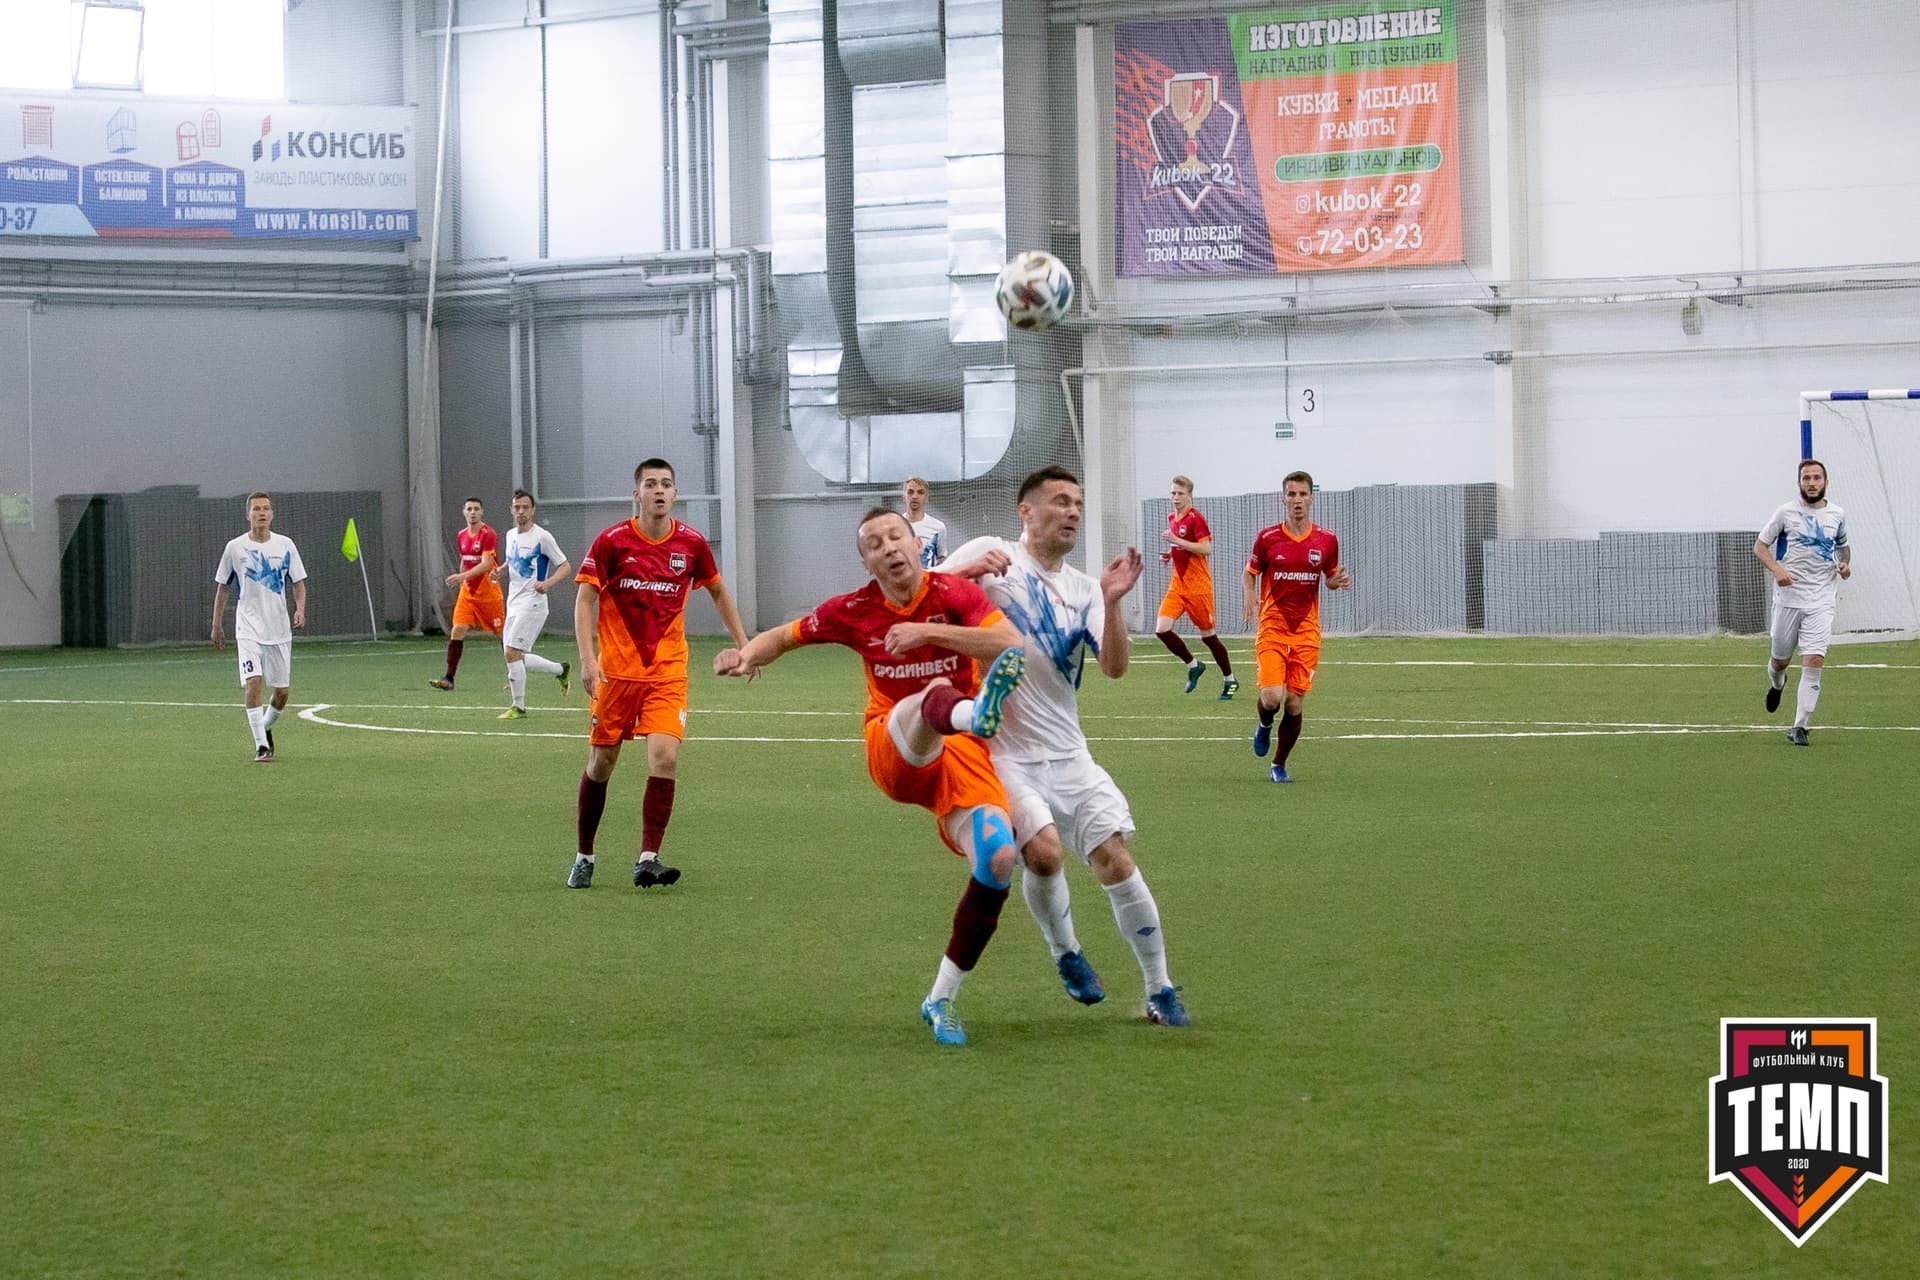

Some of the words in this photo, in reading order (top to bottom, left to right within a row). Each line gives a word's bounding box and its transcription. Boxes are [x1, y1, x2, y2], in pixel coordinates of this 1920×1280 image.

[1249, 7, 1442, 52] ИЗГОТОВЛЕНИЕ
[1250, 52, 1336, 73] НАГРАДНОЙ
[1350, 42, 1443, 67] ПРОДУКЦИИ
[1277, 91, 1340, 117] КУБКИ
[1357, 82, 1438, 111] МЕДАЛИ
[1319, 117, 1396, 142] ГРАМОТЫ
[288, 131, 406, 160] КОНСИБ
[173, 172, 196, 184] ОКНА
[199, 173, 205, 184] И
[208, 173, 237, 186] ДВЕРИ
[253, 171, 296, 186] ЗАВОДЫ
[299, 171, 376, 187] ПЛАСТИКОВЫХ
[379, 172, 407, 187] ОКОН
[175, 189, 187, 202] ИЗ
[189, 189, 236, 202] ПЛАСТИКА
[1315, 183, 1422, 213] kubok_22
[175, 207, 181, 220] И
[255, 211, 410, 231] www.konsib.com
[1146, 228, 1180, 243] ТВОИ
[1184, 225, 1242, 242] ПОБЕДЫ!
[1317, 223, 1423, 255] 72-03-23
[1146, 247, 1178, 263] ТВОИ
[1181, 245, 1243, 262] НАГРАДЫ!
[1303, 388, 1315, 413] 3
